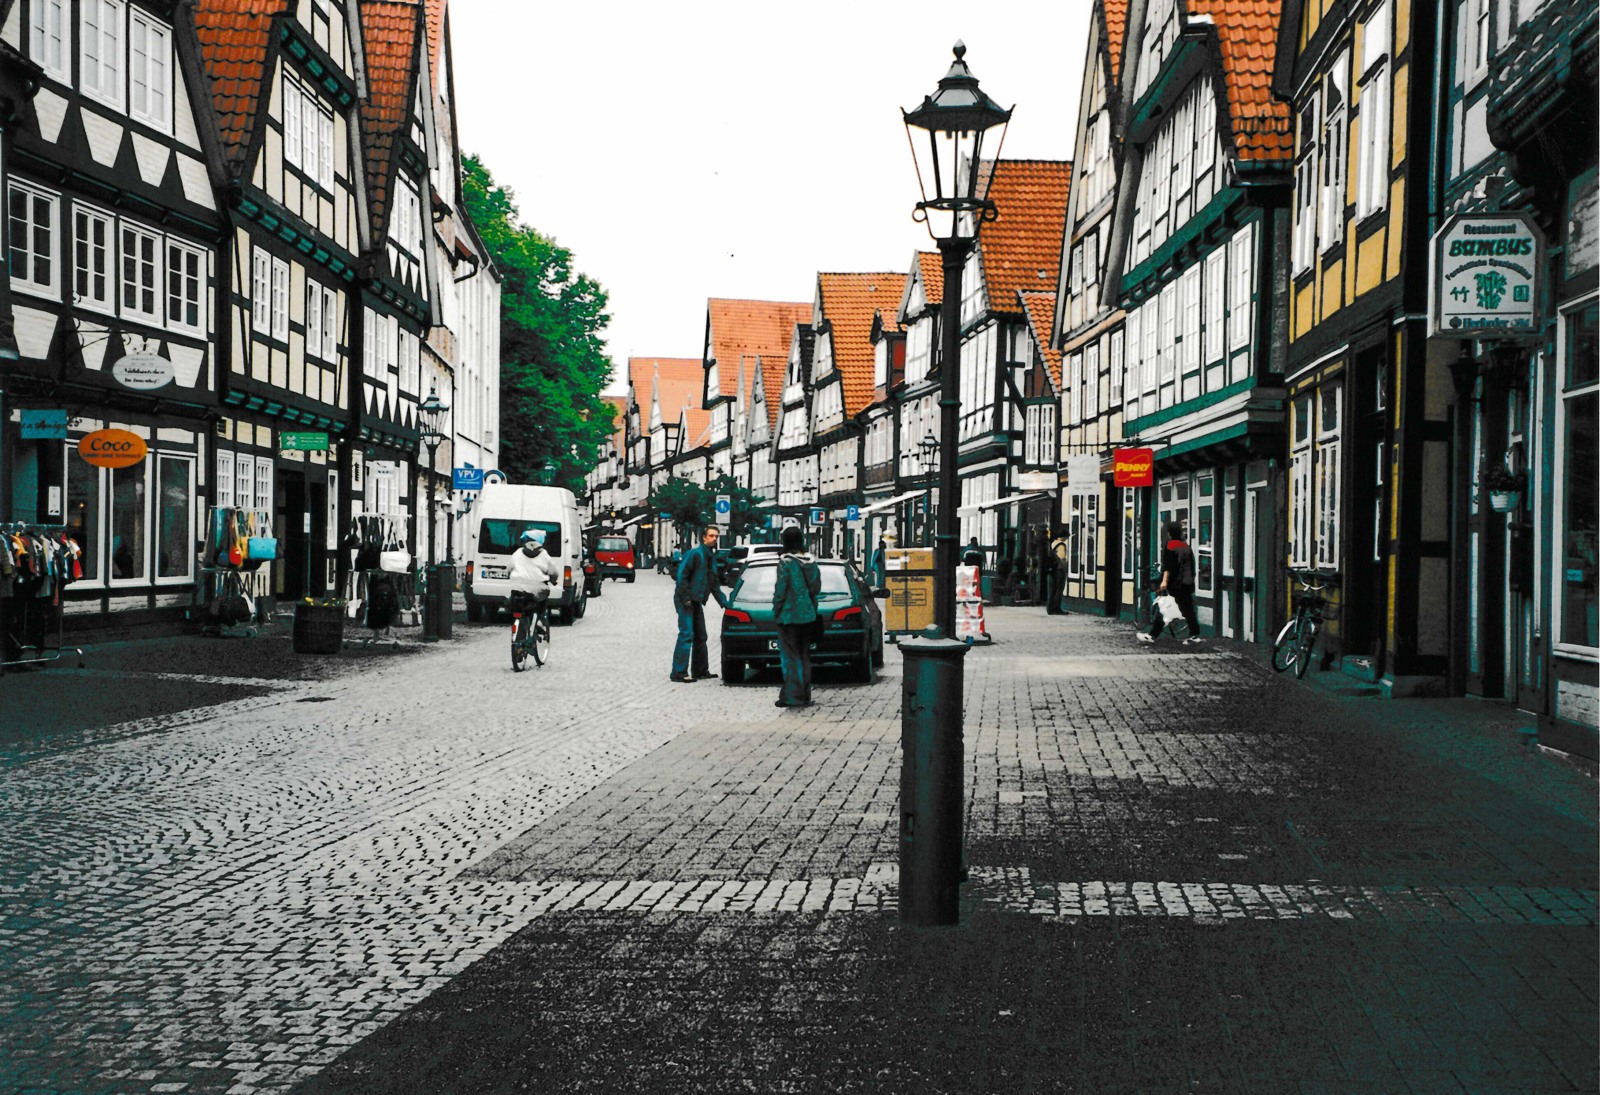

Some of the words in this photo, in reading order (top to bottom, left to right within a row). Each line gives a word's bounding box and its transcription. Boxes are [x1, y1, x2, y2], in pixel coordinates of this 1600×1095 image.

[1463, 223, 1517, 235] Restaurant
[91, 438, 134, 452] Coco
[1115, 462, 1151, 472] PENNY
[457, 469, 476, 478] VPV
[849, 508, 856, 519] P
